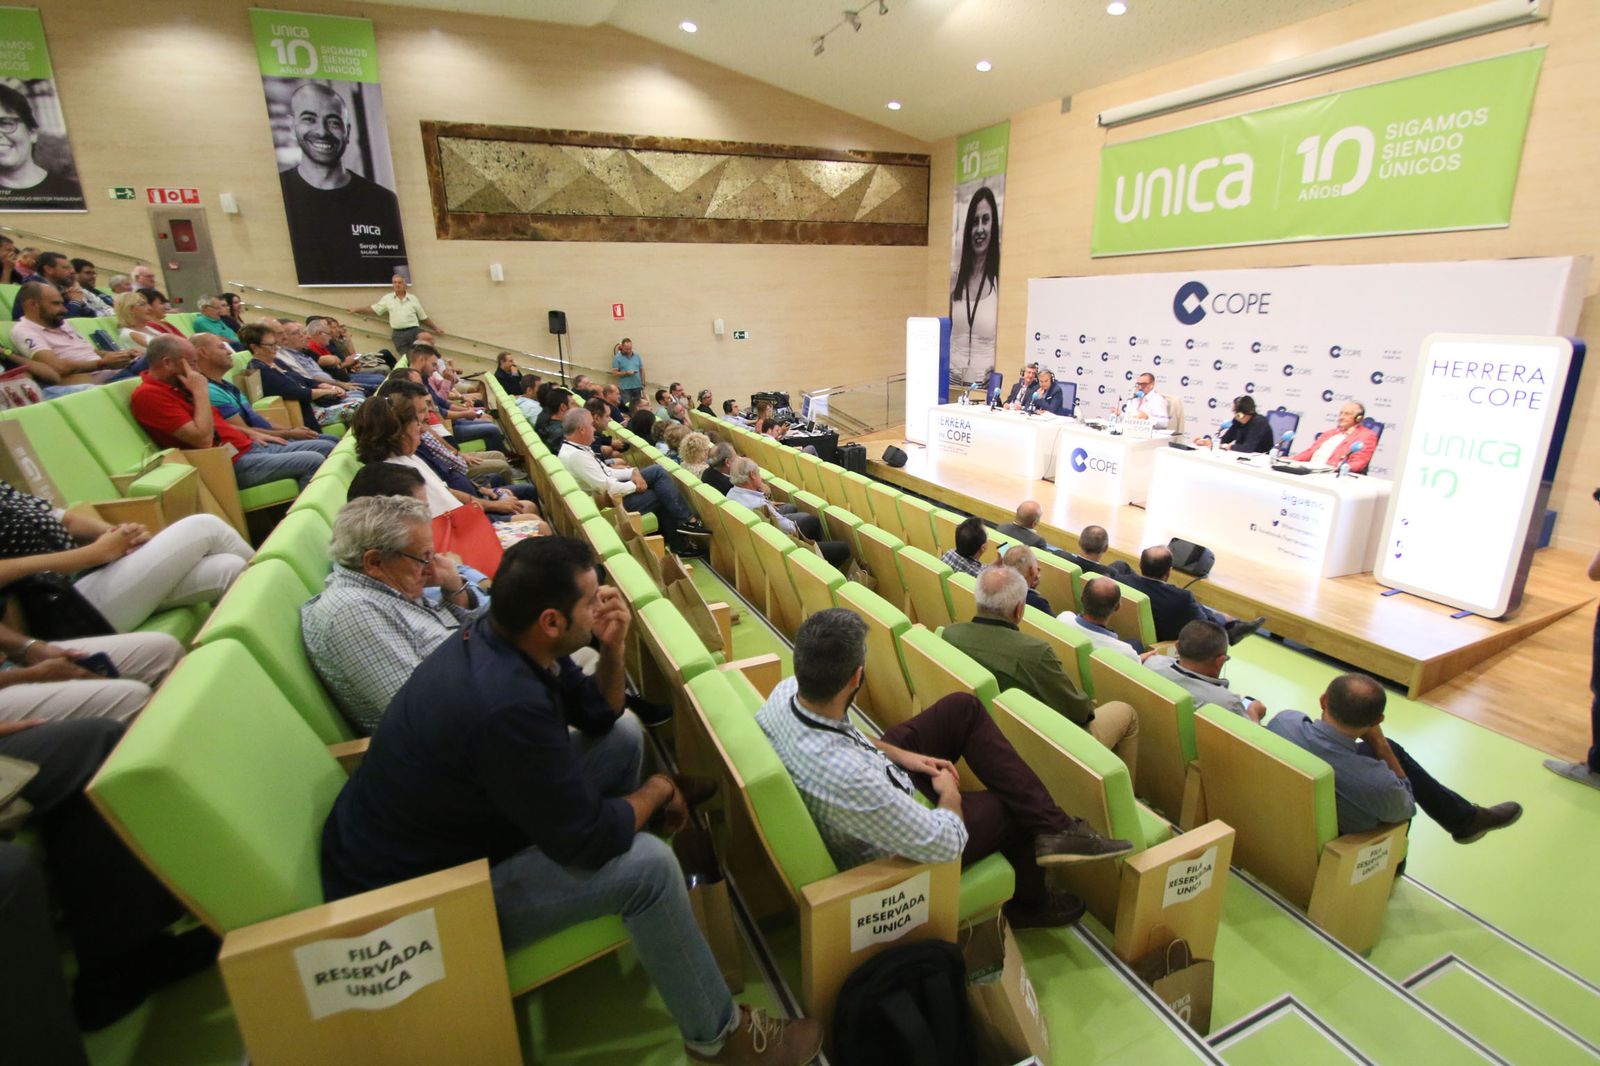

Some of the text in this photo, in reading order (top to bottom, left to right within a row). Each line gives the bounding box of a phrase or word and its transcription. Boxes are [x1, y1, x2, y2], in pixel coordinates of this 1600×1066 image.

[270, 38, 318, 75] 10
[1385, 107, 1489, 141] SIGAMOS
[1382, 133, 1463, 160] SIENDO
[1296, 126, 1376, 196] 10
[1378, 153, 1462, 180] ÚNICOS
[1114, 152, 1254, 223] unica
[1298, 183, 1341, 201] AÑOS
[1212, 292, 1272, 314] COPE
[1431, 360, 1546, 385] HERRERA
[1468, 386, 1544, 410] COPE
[946, 429, 972, 443] COPE
[1089, 457, 1118, 475] COPE
[857, 893, 926, 929] RESERVADA
[881, 891, 906, 909] FILA
[872, 914, 912, 936] UNICA
[313, 939, 435, 987] RESERVADA
[348, 939, 393, 963] FILA
[346, 970, 412, 998] UNICA
